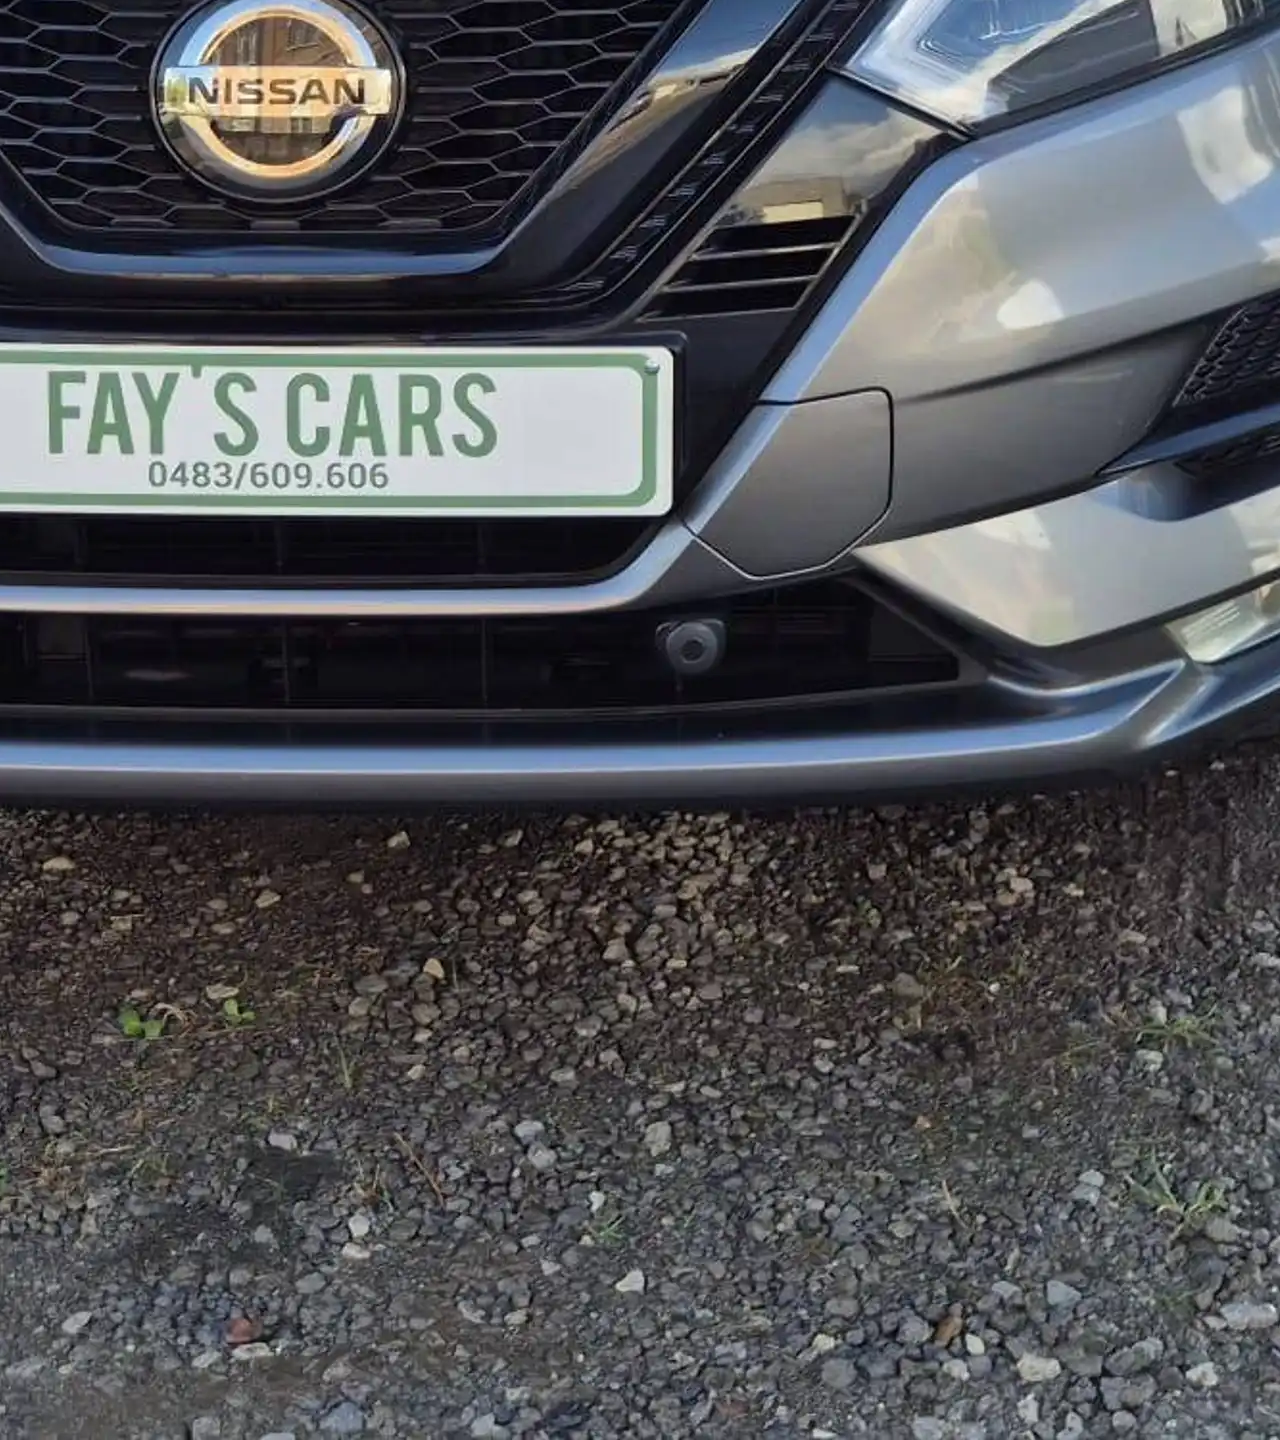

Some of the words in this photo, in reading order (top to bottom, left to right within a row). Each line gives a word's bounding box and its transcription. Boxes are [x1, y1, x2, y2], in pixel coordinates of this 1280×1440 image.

[188, 77, 365, 105] NISSAN
[47, 365, 259, 456] FAY'S
[285, 372, 498, 458] CARS
[148, 460, 389, 491] 0483/609.606
